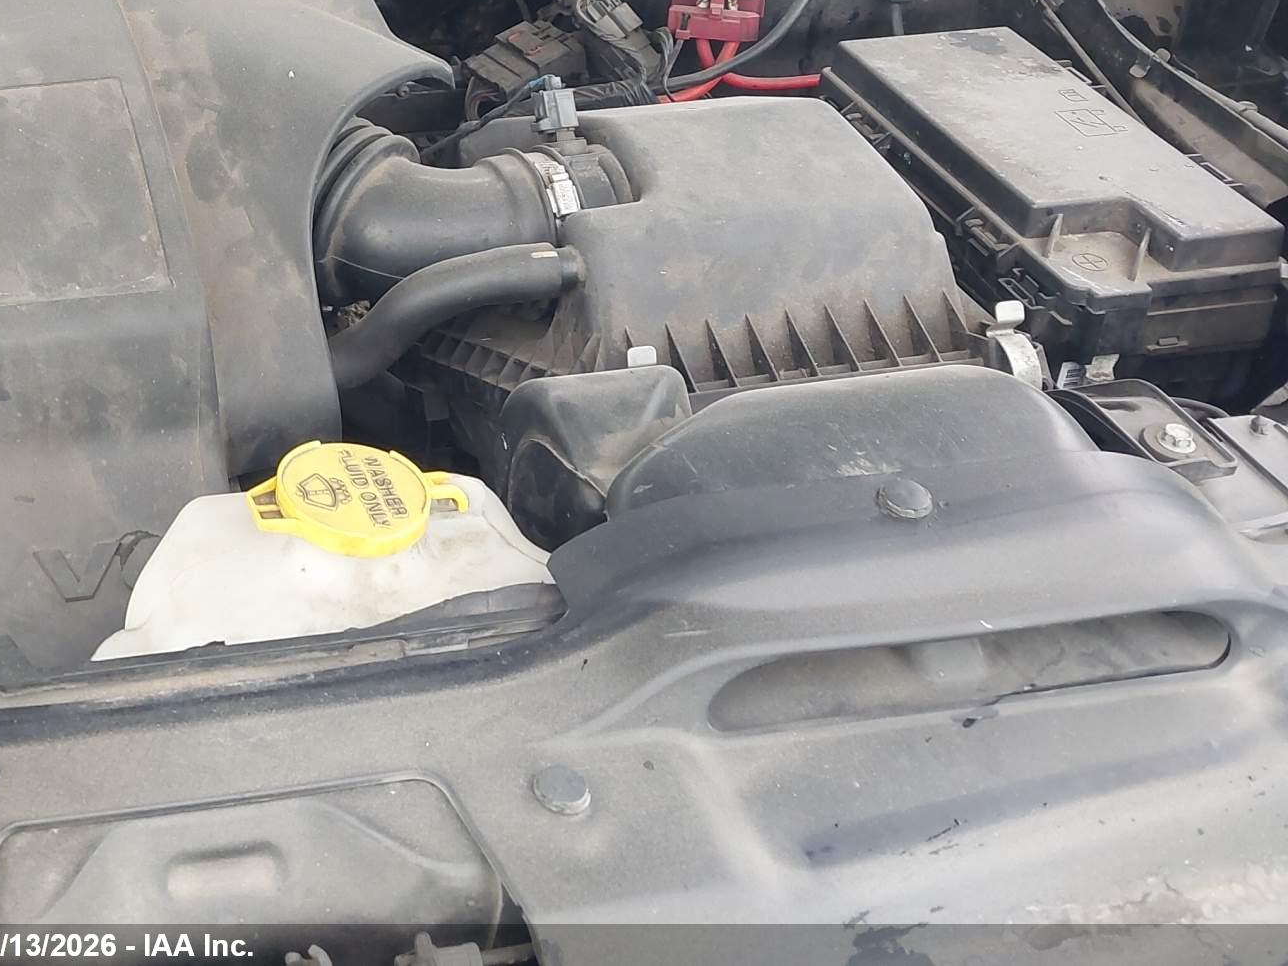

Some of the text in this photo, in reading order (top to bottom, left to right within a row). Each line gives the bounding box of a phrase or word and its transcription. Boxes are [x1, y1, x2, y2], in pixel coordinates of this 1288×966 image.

[338, 449, 392, 529] FLUID ONLY
[364, 456, 409, 520] WASHER
